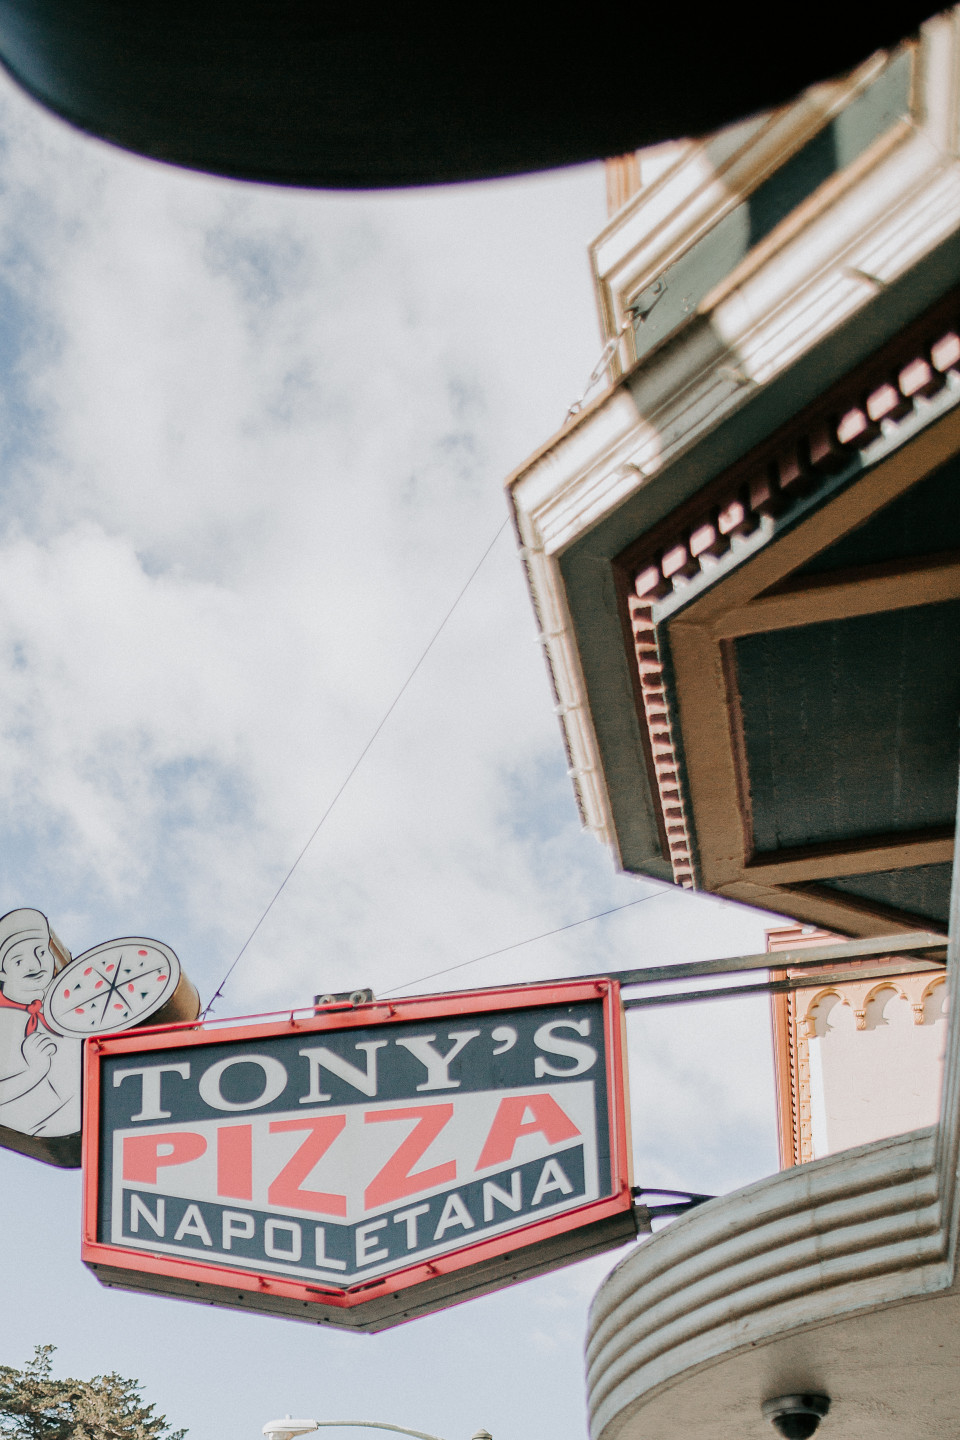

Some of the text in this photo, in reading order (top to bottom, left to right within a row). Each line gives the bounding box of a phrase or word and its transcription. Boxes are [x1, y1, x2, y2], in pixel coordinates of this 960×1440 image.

[113, 1018, 598, 1122] TONY'S
[122, 1092, 582, 1218] PIZZA
[129, 1158, 574, 1271] NAPOLETANA
